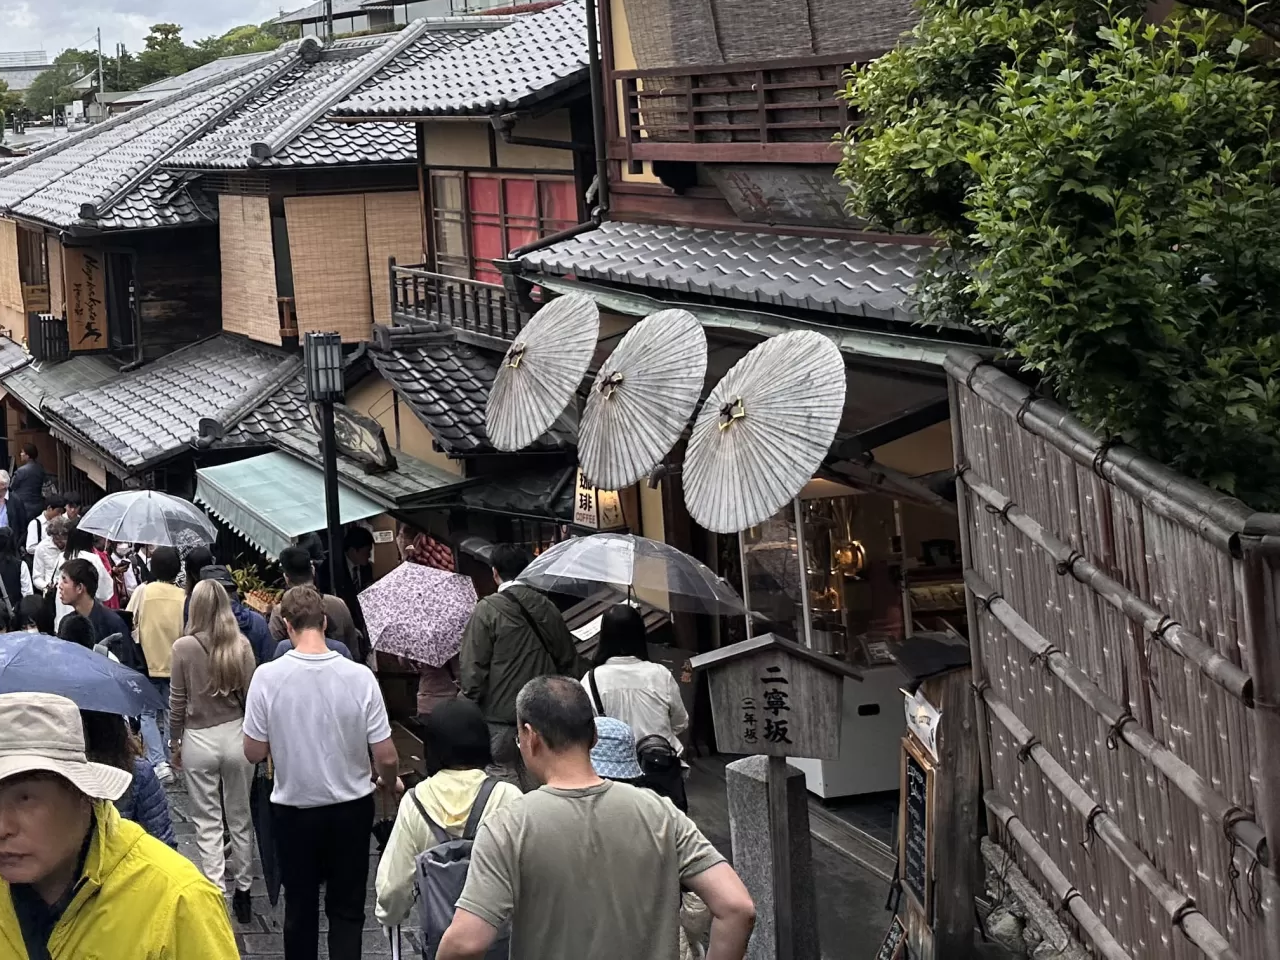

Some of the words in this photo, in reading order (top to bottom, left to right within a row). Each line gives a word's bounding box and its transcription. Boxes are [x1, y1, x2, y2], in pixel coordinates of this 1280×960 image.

[576, 511, 596, 525] COFFEE
[760, 665, 793, 745] 二寧坂
